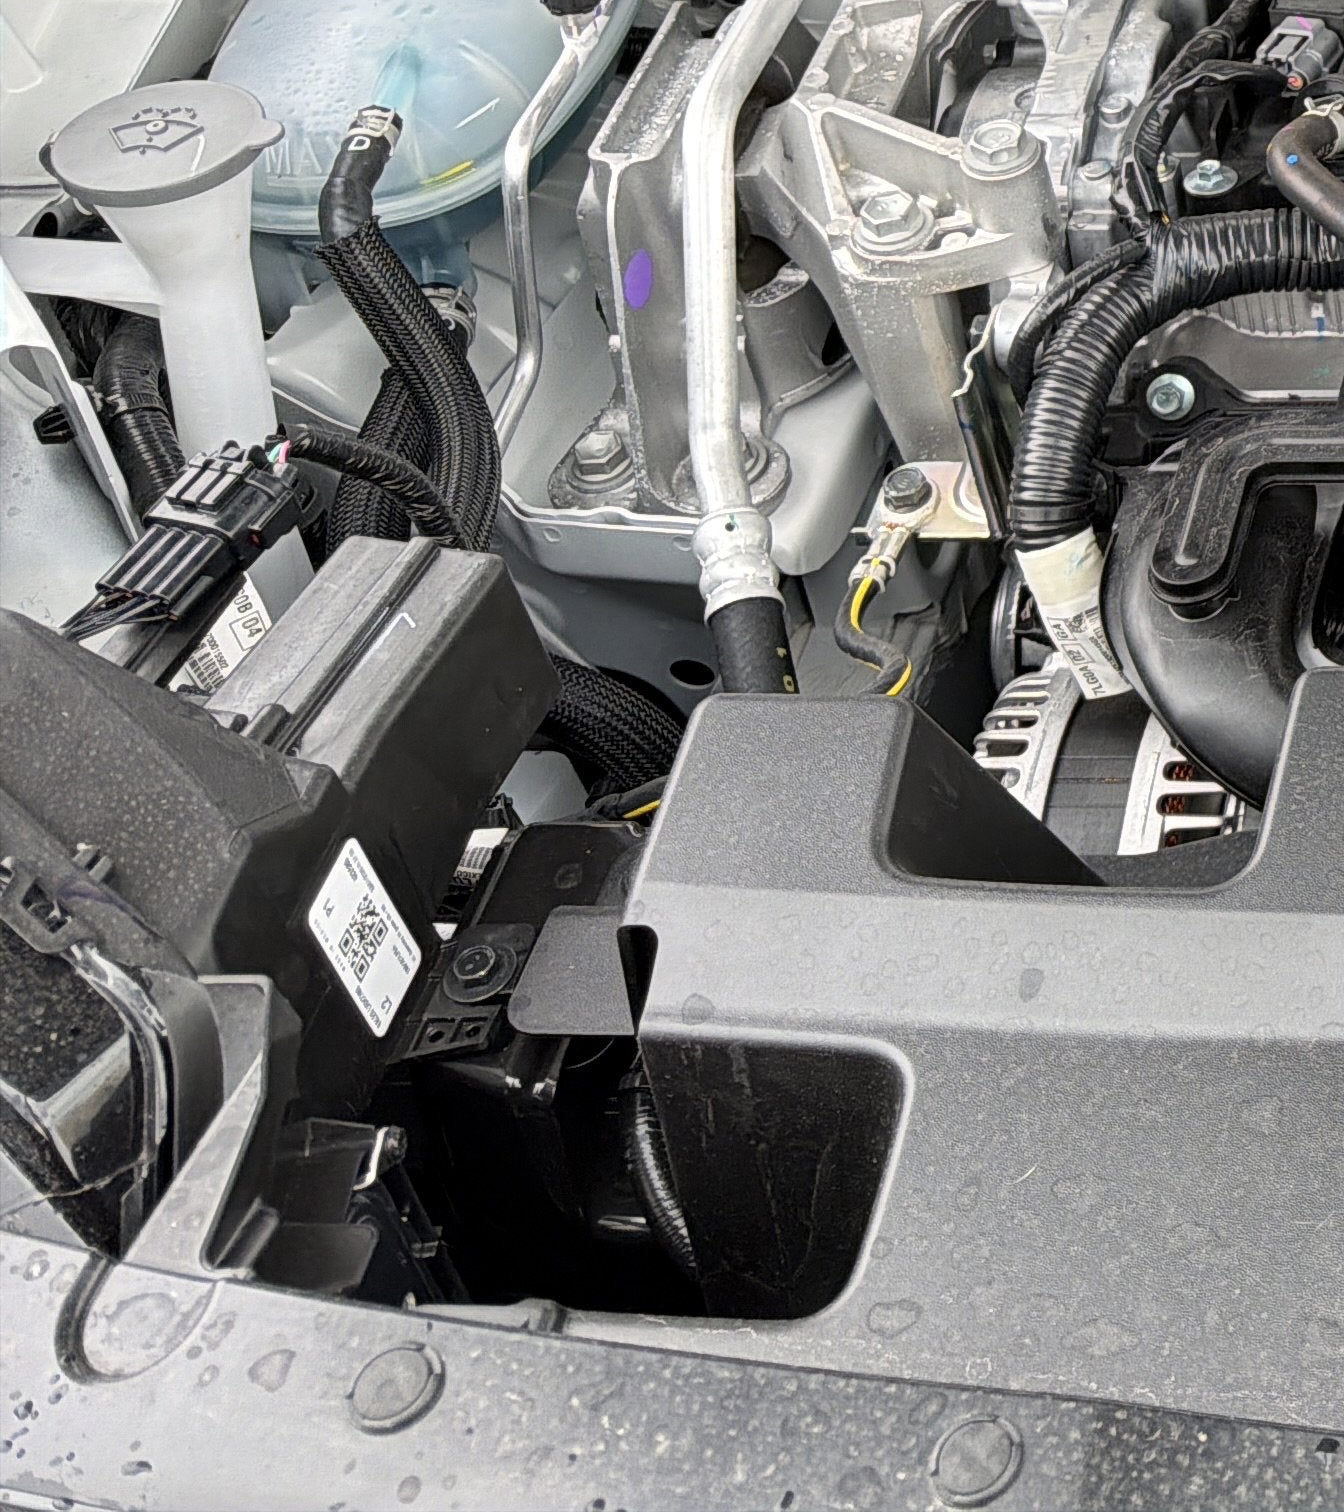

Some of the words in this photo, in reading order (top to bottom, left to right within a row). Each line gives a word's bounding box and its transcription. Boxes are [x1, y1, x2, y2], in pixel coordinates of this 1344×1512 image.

[347, 136, 371, 152] D
[322, 897, 336, 918] P1
[380, 995, 393, 1015] L2
